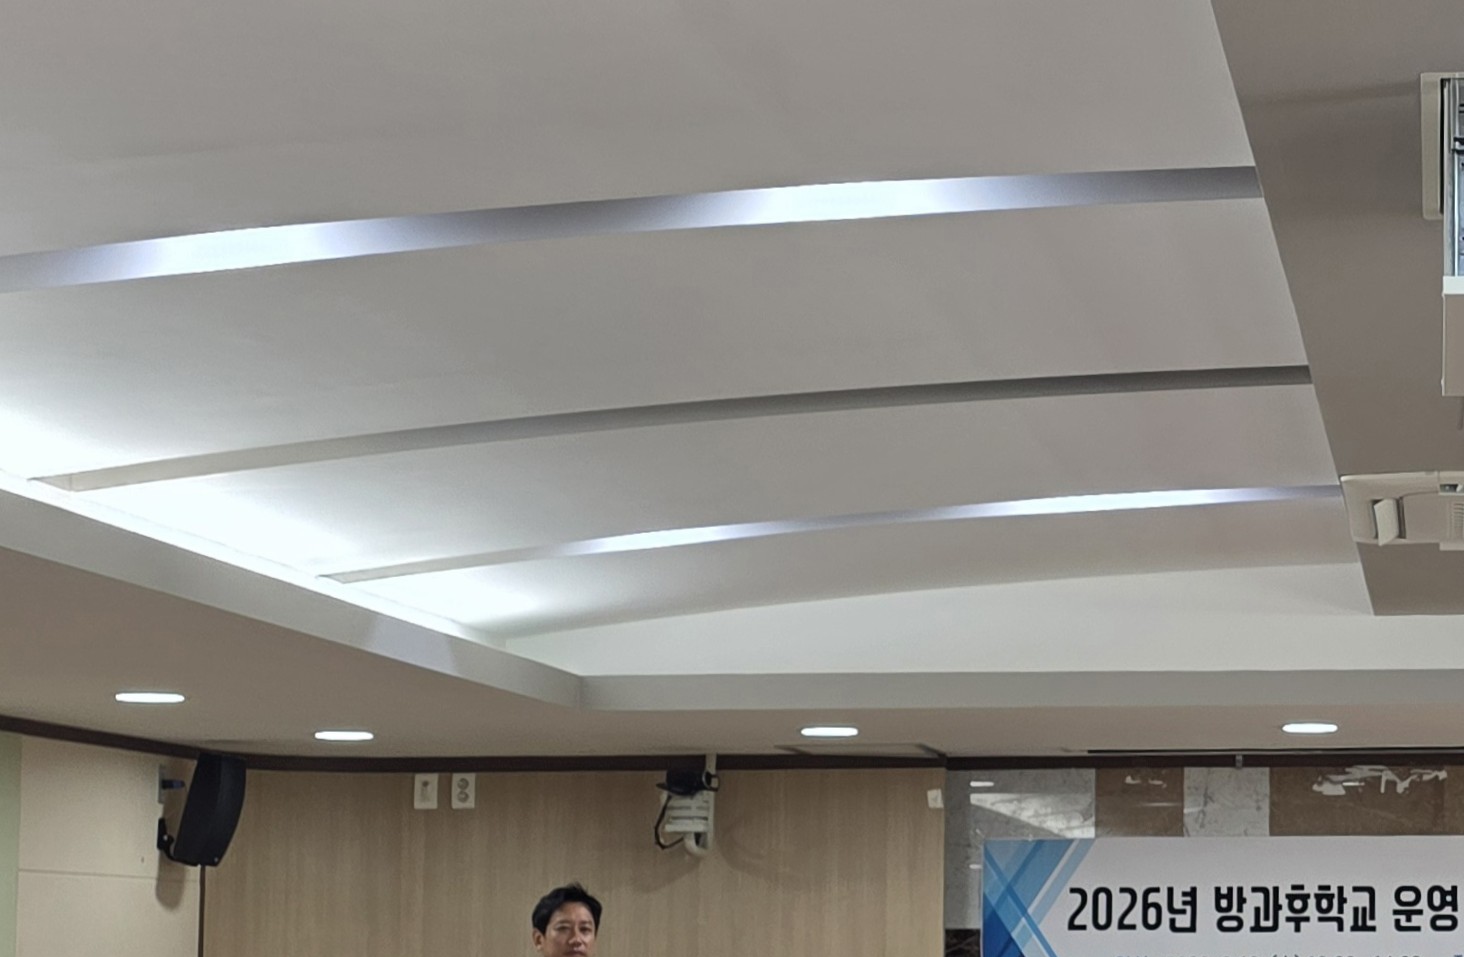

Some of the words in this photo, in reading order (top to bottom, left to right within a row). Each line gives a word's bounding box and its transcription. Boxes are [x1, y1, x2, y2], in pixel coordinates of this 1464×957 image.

[1067, 885, 1198, 934] 2026년
[1213, 883, 1377, 933] 방과후학교
[1392, 884, 1459, 933] 운영
